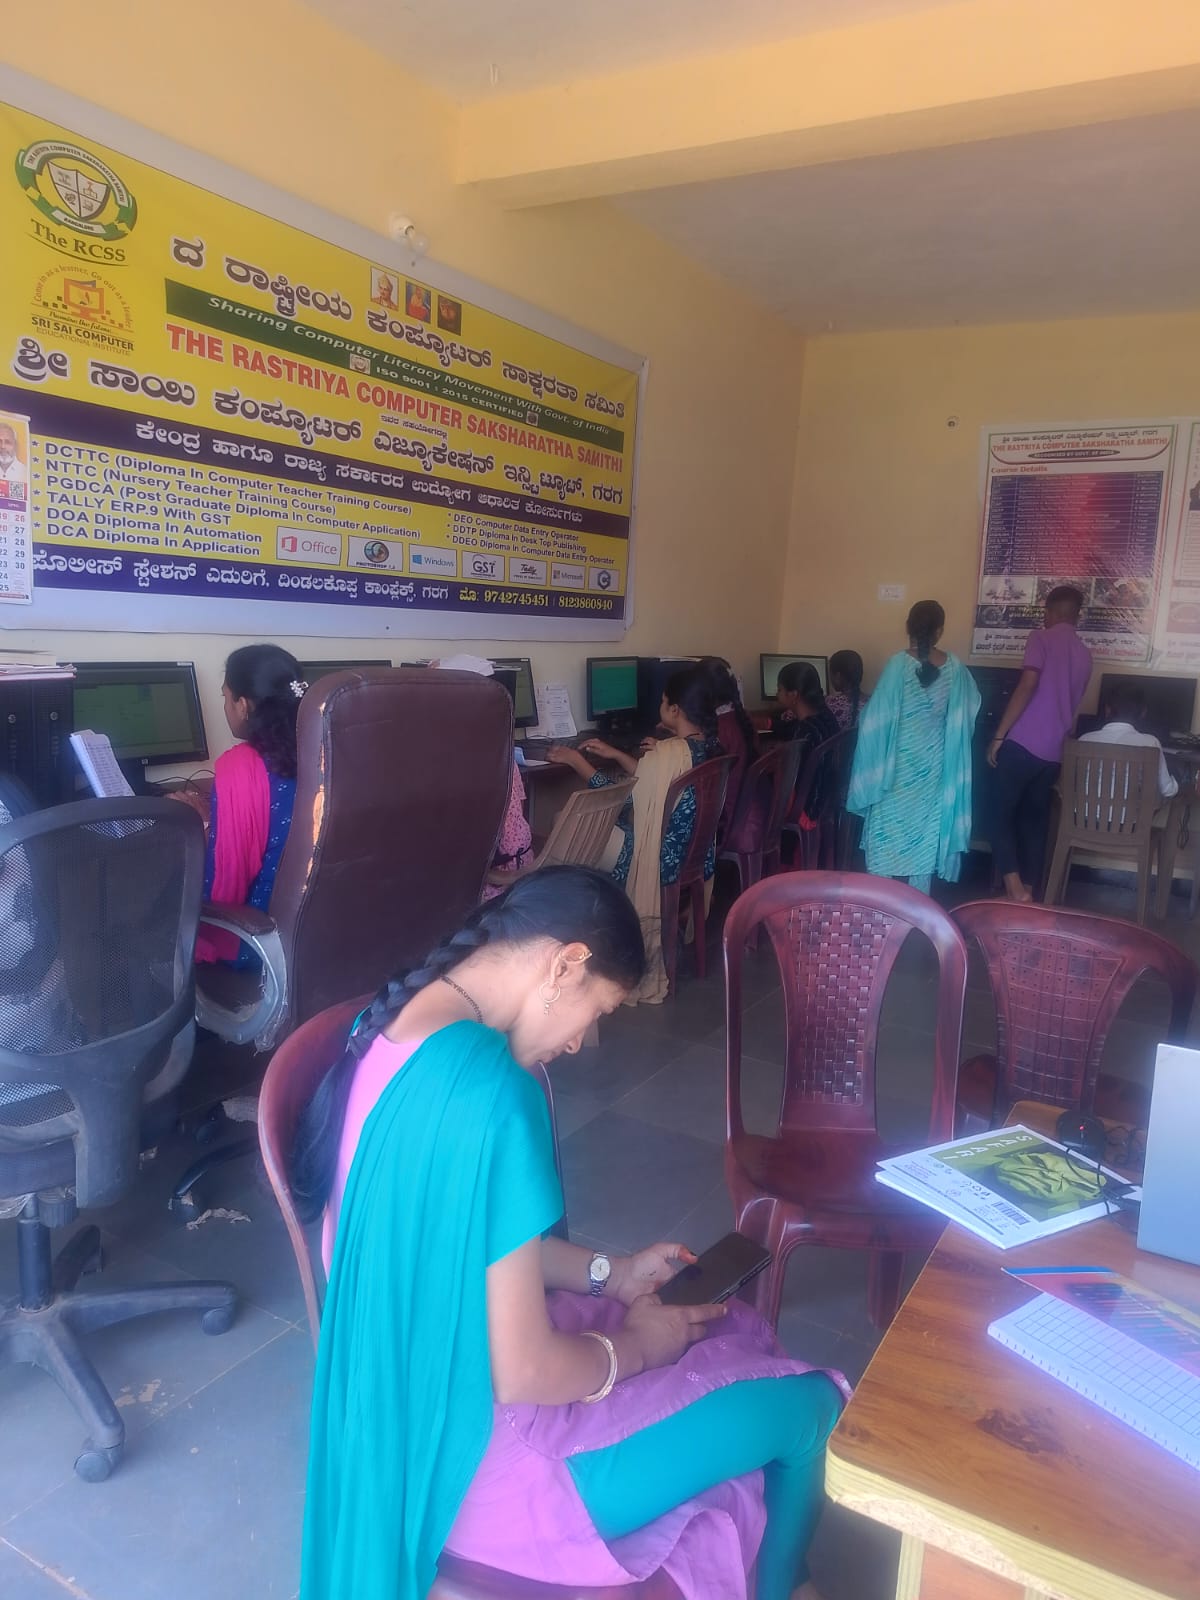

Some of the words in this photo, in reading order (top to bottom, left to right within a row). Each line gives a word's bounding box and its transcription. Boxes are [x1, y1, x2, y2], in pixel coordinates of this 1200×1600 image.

[30, 218, 68, 249] The
[73, 238, 126, 262] RCSS
[32, 316, 51, 328] SRI
[54, 322, 72, 333] SAI
[75, 328, 134, 351] COMPUTER
[36, 327, 91, 346] EDUCATIONAL
[92, 342, 131, 356] INSTITUTE
[173, 238, 204, 268] ದ
[225, 256, 352, 317] ರಾಷ್ಟ್ರೀಯ
[367, 310, 492, 367] ಕಂಪ್ಯೂಟರ್
[502, 360, 580, 401] ಸಾಕ್ಷರತಾ
[584, 391, 626, 418] ಸಮಿತಿ
[208, 297, 288, 332] Sharing
[293, 324, 380, 360] Computer
[383, 353, 441, 381] Literacy
[445, 375, 514, 404] Movement
[516, 398, 543, 415] With
[544, 407, 571, 425] Govt.
[572, 417, 585, 429] of
[585, 421, 609, 436] India
[166, 323, 224, 363] THE
[232, 342, 350, 400] RASTRIYA
[356, 382, 462, 430] COMPUTER
[467, 414, 574, 460] SAKSHARATHA
[577, 446, 623, 473] SAMITHI
[376, 366, 399, 379] ISO
[402, 375, 431, 390] 9001
[441, 386, 469, 401] 2015
[471, 395, 524, 419] CERTIFIED
[14, 338, 68, 381] ಶ್ರೀ
[90, 361, 195, 406] ಸಾಯಿ
[214, 389, 361, 446] ಕಂಪ್ಯೂಟರ್
[374, 430, 494, 474] ಎಜ್ಯೂಕೇಷನ್
[592, 483, 623, 505] ಗರಗ
[1008, 443, 1040, 451] RASTRIYA
[1042, 441, 1081, 449] COMPUTER
[1082, 438, 1136, 448] SAKSHARATHA
[1137, 436, 1168, 446] SAMITHI
[45, 442, 110, 464] DCTTC
[115, 455, 186, 477] (Diploma
[190, 468, 204, 480] In
[208, 471, 273, 492] Computer
[277, 483, 323, 500] Teacher
[327, 492, 370, 510] Training
[373, 500, 412, 516] Course)
[136, 421, 201, 455] ಕೇಂದ್ರ
[212, 439, 274, 463] ಹಾಗೂ
[284, 453, 327, 482] ರಾಜ್ಯ
[336, 462, 404, 489] ಸರ್ಕಾರದ
[411, 479, 471, 505] ಉದ್ಯೋಗ
[477, 492, 521, 511] ಆಧಾರಿತ
[525, 501, 583, 523] ಕೋರ್ಸುಗಳು
[991, 466, 1019, 474] Course
[1020, 465, 1048, 473] Details
[46, 459, 97, 477] NTTC
[103, 468, 170, 491] (Nursery
[176, 480, 233, 499] Teacher
[237, 489, 288, 509] Training
[291, 498, 336, 516] Course)
[47, 475, 115, 496] PGDCA
[119, 486, 161, 502] (Post
[165, 493, 231, 513] Graduate
[235, 503, 289, 521] Diploma
[292, 511, 303, 522] In
[306, 514, 360, 532] Computer
[362, 523, 421, 540] Application)
[47, 491, 105, 509] TALLY
[110, 500, 159, 516] ERP.9
[163, 507, 196, 521] With
[200, 512, 232, 525] GST
[47, 508, 90, 523] DOA
[94, 513, 161, 531] Diploma
[165, 522, 179, 533] In
[183, 525, 262, 543] Automation
[47, 524, 89, 538] DCA
[94, 528, 160, 546] Diploma
[165, 536, 178, 547] In
[182, 538, 260, 556] Application
[453, 525, 477, 535] DDTP
[479, 529, 510, 541] Diploma
[520, 536, 538, 545] Desk
[540, 539, 551, 547] Top
[553, 541, 587, 554] Publishing
[454, 513, 473, 524] DEO
[476, 518, 512, 531] Computer
[514, 524, 530, 534] Data
[531, 526, 550, 537] Entry
[551, 531, 579, 542] Operator
[15, 538, 25, 546] 28
[15, 550, 25, 558] 29
[301, 539, 337, 556] Office
[452, 536, 478, 546] DDEO
[480, 539, 511, 552] Diploma
[512, 544, 519, 552] In
[521, 546, 554, 559] Computer
[556, 551, 570, 560] Data
[571, 553, 587, 563] Entry
[589, 555, 615, 565] Operator
[15, 562, 25, 570] 30
[424, 557, 454, 568] Windows
[472, 560, 497, 574] GST
[520, 564, 537, 576] Tally
[561, 572, 583, 580] Microsoft
[133, 558, 197, 587] ಸ್ಟೇಶನ್
[278, 573, 358, 598] ದಿಂಡಲಕೊಪ್ಪ
[422, 585, 448, 599] ಗರಗ
[484, 590, 549, 607] 9742745451
[942, 1136, 1032, 1160] SAFARI
